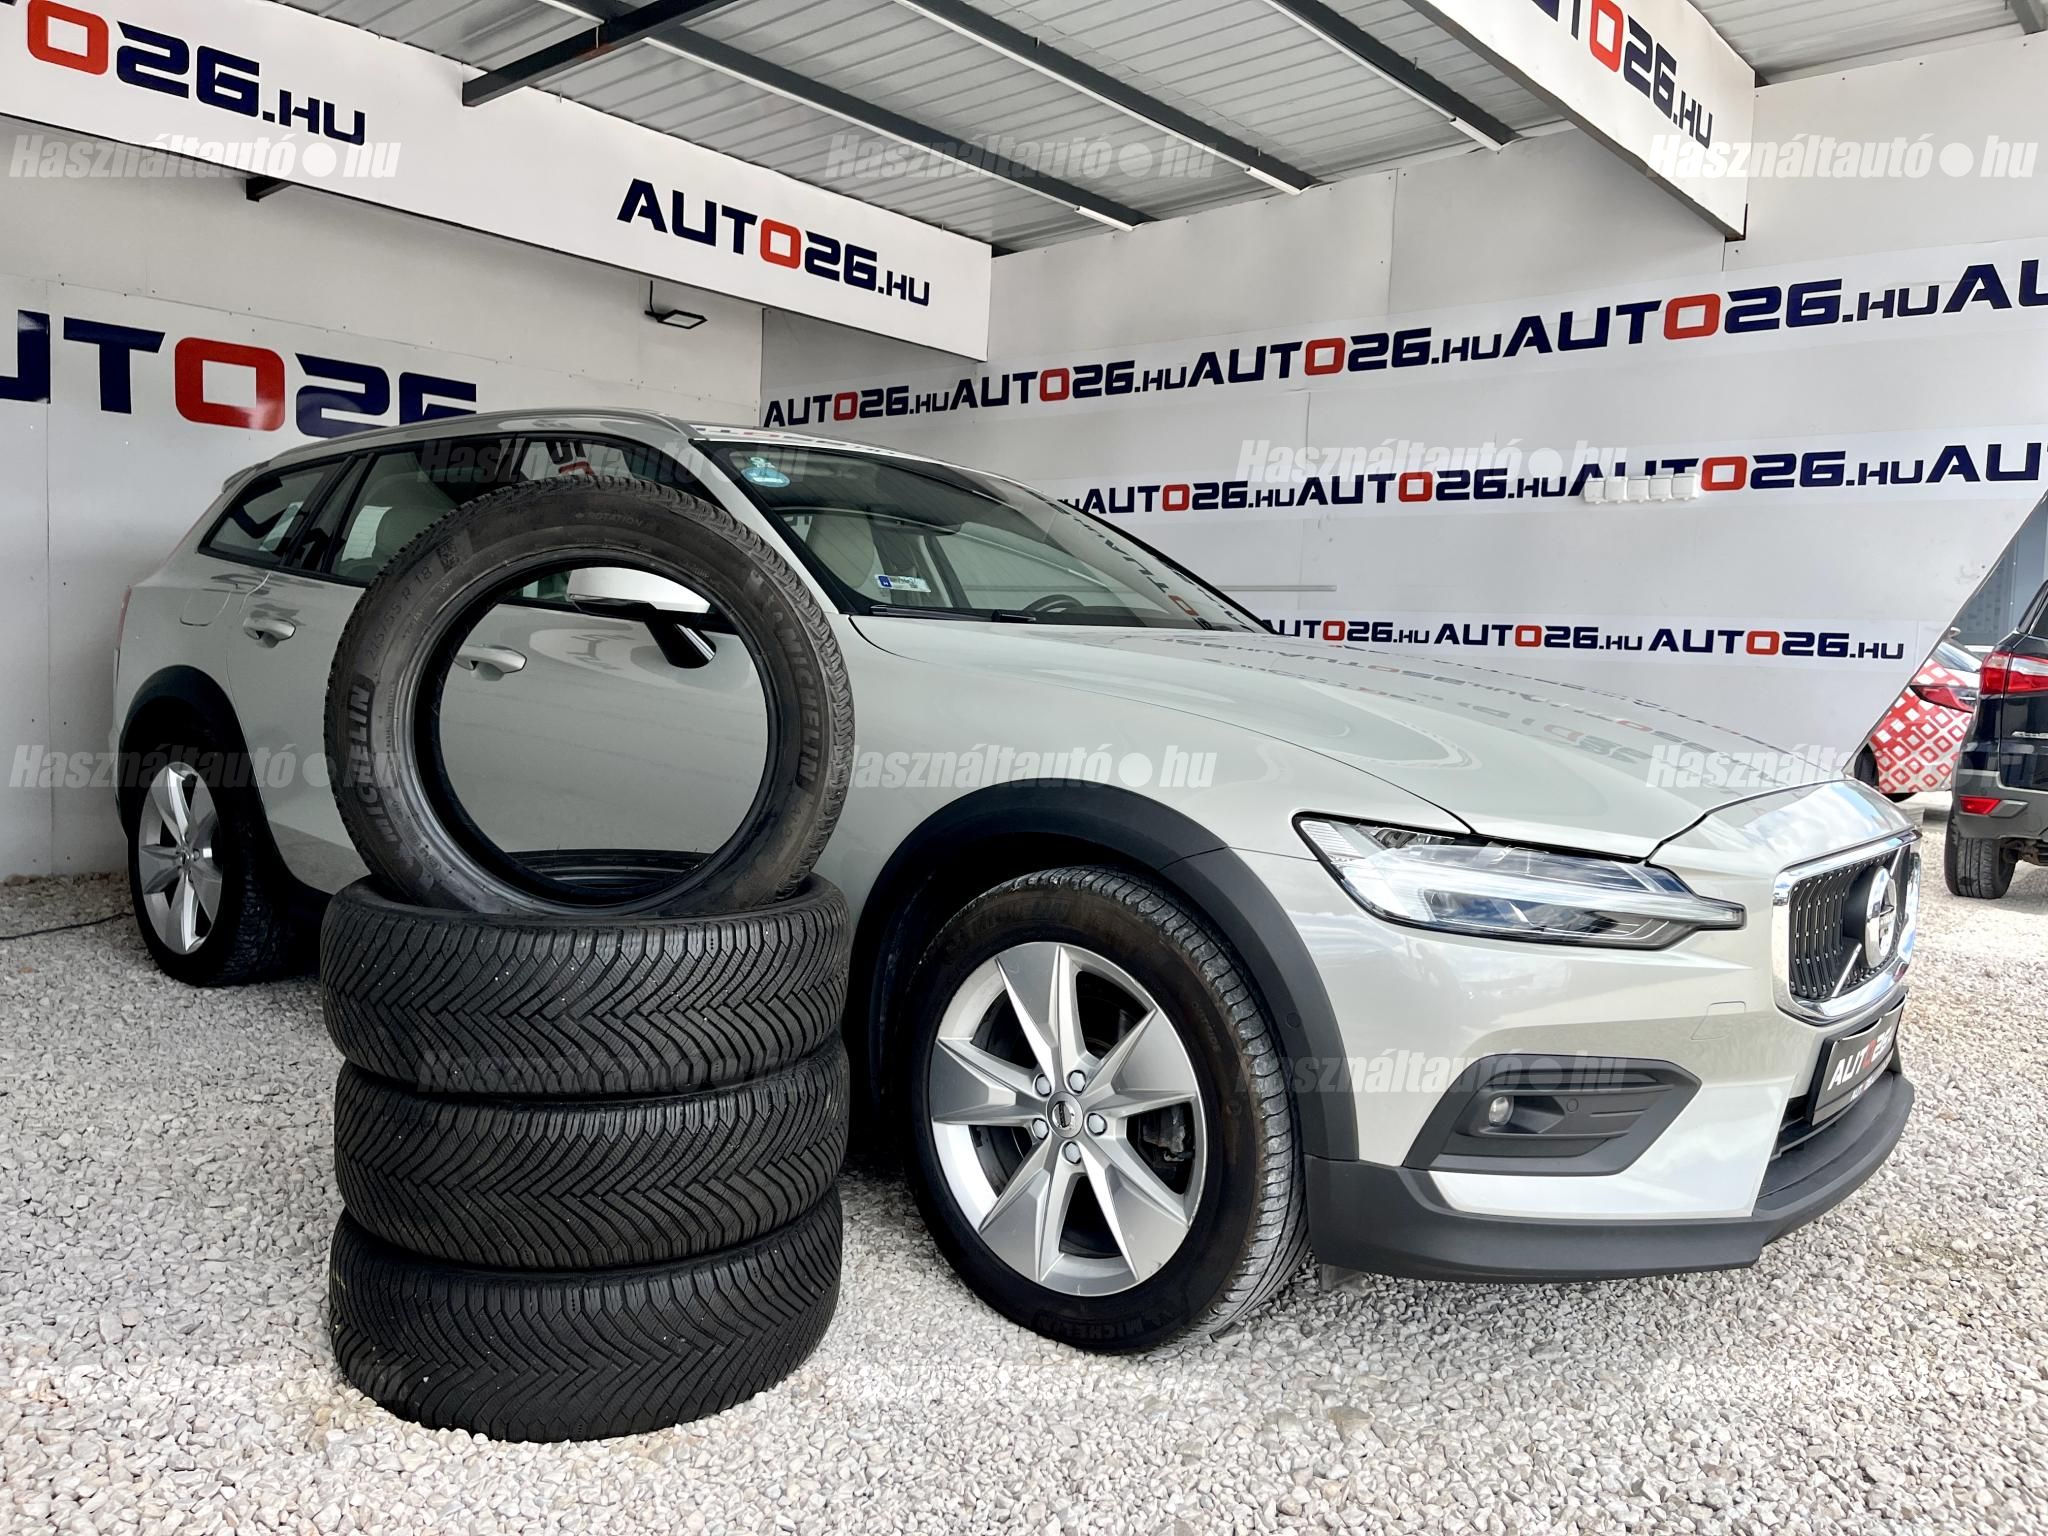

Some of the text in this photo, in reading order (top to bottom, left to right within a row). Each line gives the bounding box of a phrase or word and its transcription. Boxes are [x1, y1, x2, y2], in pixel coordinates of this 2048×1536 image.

[0, 0, 366, 146] O26.HU
[1533, 0, 1713, 149] O26.HU
[617, 179, 930, 307] AUTO26.HU
[763, 385, 950, 429] AUTO26.HU
[950, 360, 1188, 411] AUTO26.HU
[1188, 328, 1502, 388] AUTO26.HU
[1503, 279, 1940, 358] AUTO26.HU
[1296, 468, 1567, 507] AUTO26.HU
[779, 628, 820, 782] MICHELIN
[1434, 624, 1643, 651] AUTO26.HU
[1648, 629, 1904, 660] AUTO26.HU
[350, 684, 399, 842] MICHELIN
